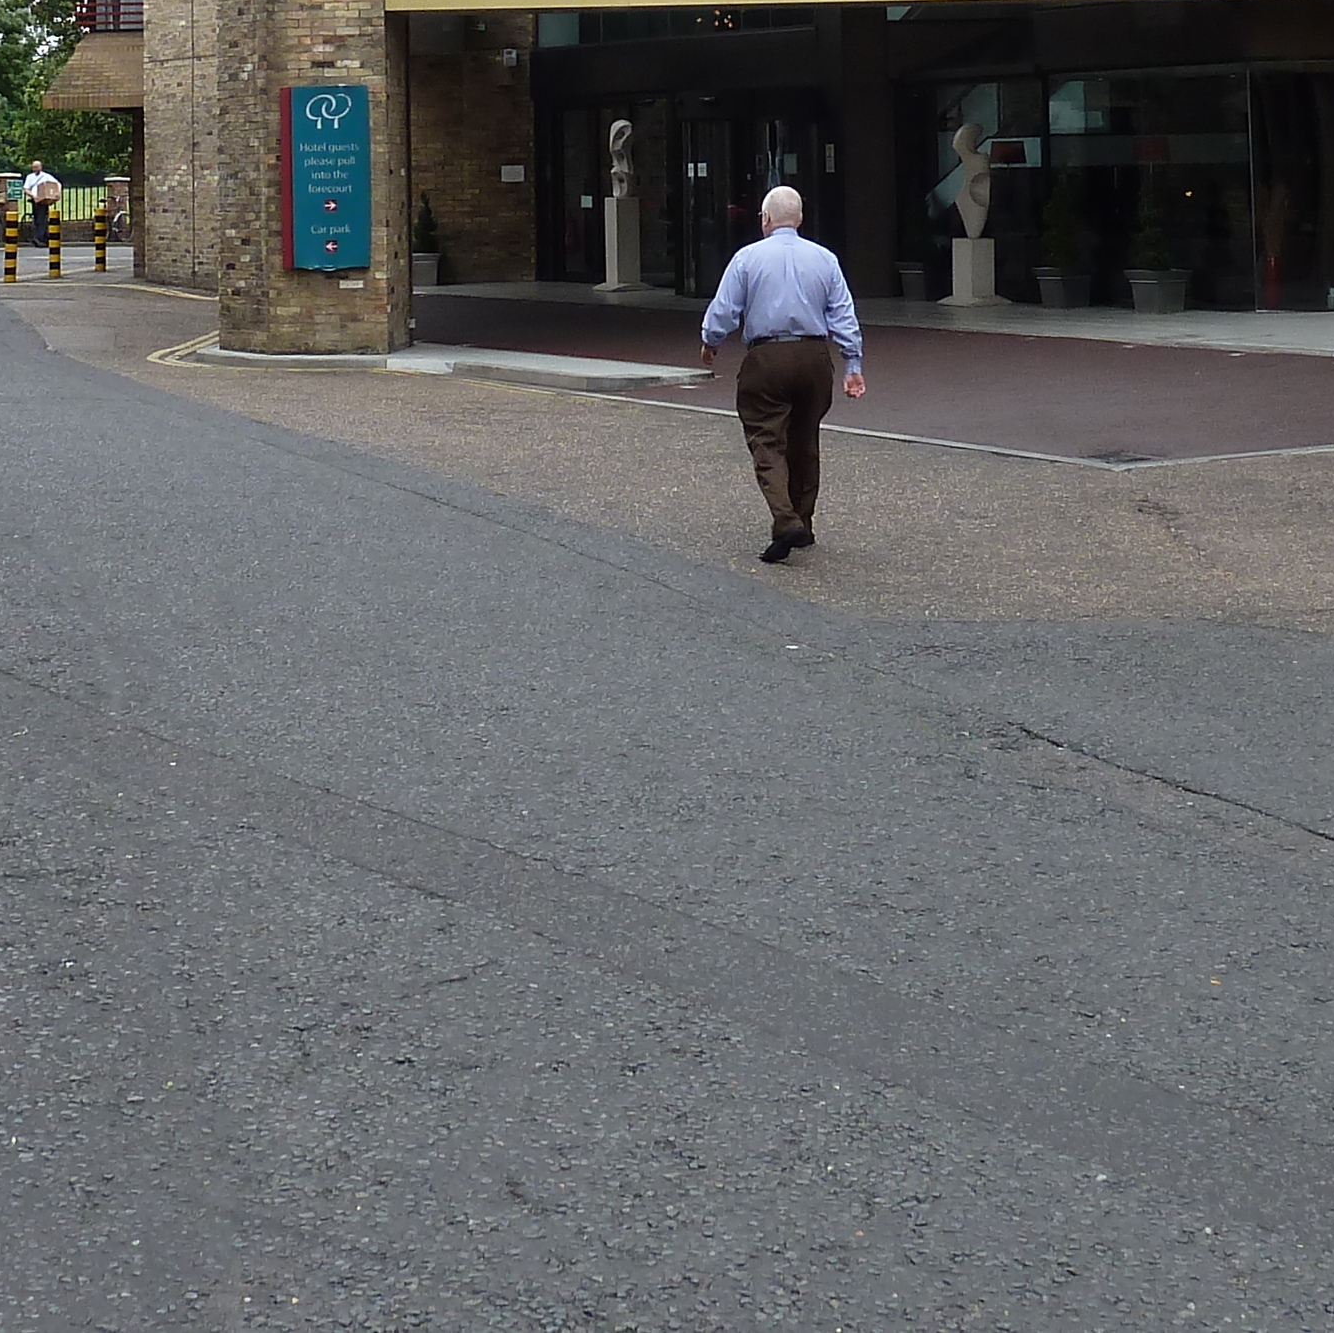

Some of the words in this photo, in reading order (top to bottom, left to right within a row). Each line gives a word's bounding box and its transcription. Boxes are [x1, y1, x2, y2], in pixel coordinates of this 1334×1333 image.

[299, 143, 327, 153] Hotel
[328, 143, 360, 154] guests
[304, 157, 336, 168] please
[337, 156, 356, 167] pull
[311, 170, 332, 180] into
[333, 169, 349, 180] the
[308, 184, 353, 194] forecourt
[310, 225, 327, 235] Car
[329, 223, 352, 236] park
